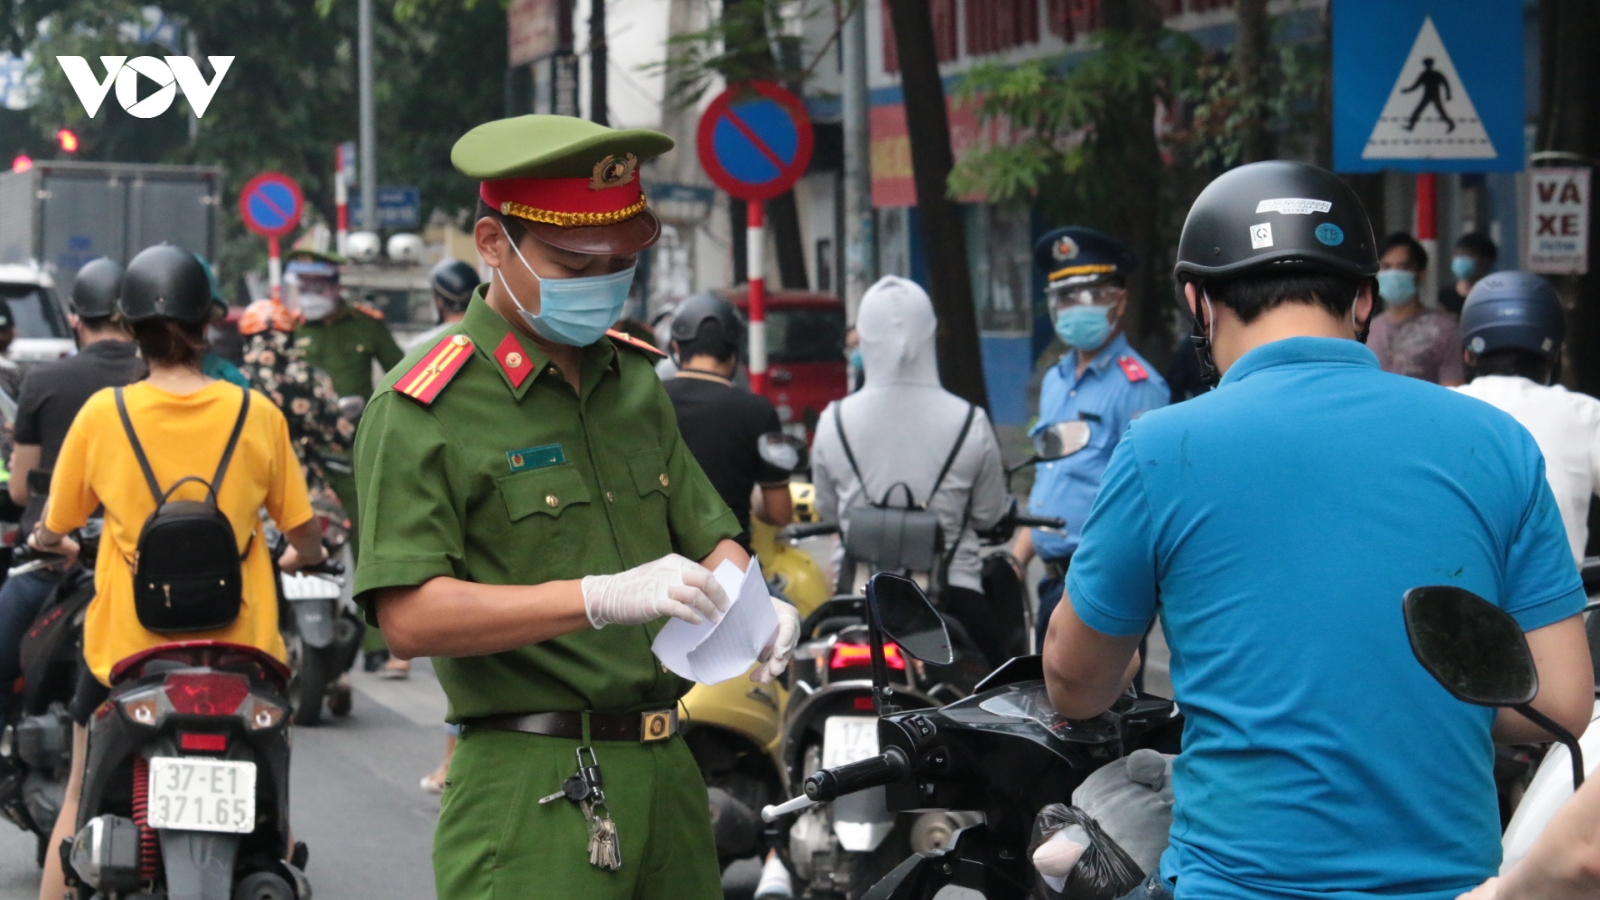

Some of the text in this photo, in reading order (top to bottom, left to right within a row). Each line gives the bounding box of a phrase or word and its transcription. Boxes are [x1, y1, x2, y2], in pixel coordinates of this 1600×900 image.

[1537, 213, 1579, 236] XE
[167, 764, 236, 794] 37-E1
[158, 795, 246, 825] 371.65
